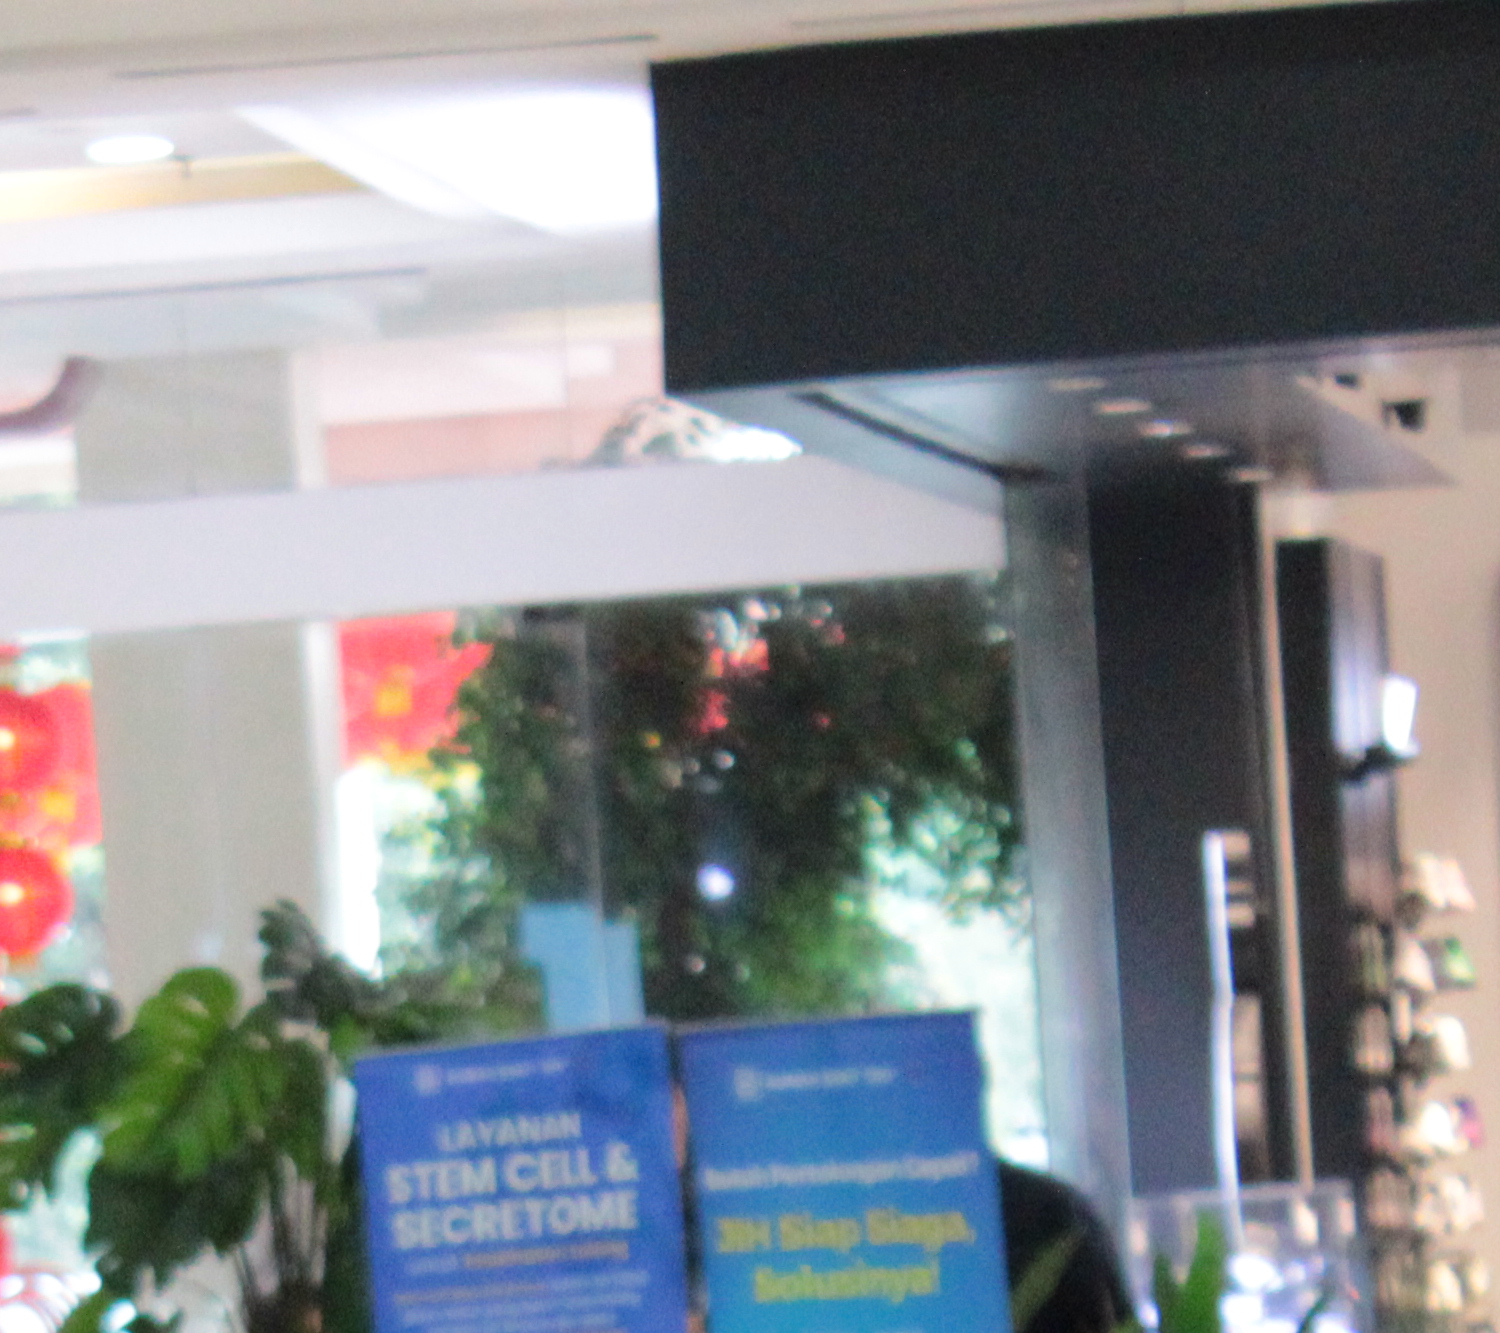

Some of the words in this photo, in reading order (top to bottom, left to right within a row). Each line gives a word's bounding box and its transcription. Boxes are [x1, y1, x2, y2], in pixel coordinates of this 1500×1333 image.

[438, 1112, 581, 1151] LAYANAN
[386, 1157, 497, 1204] STEM
[504, 1146, 598, 1192] CELL
[605, 1141, 639, 1181] &
[393, 1190, 638, 1248] SECRETOME
